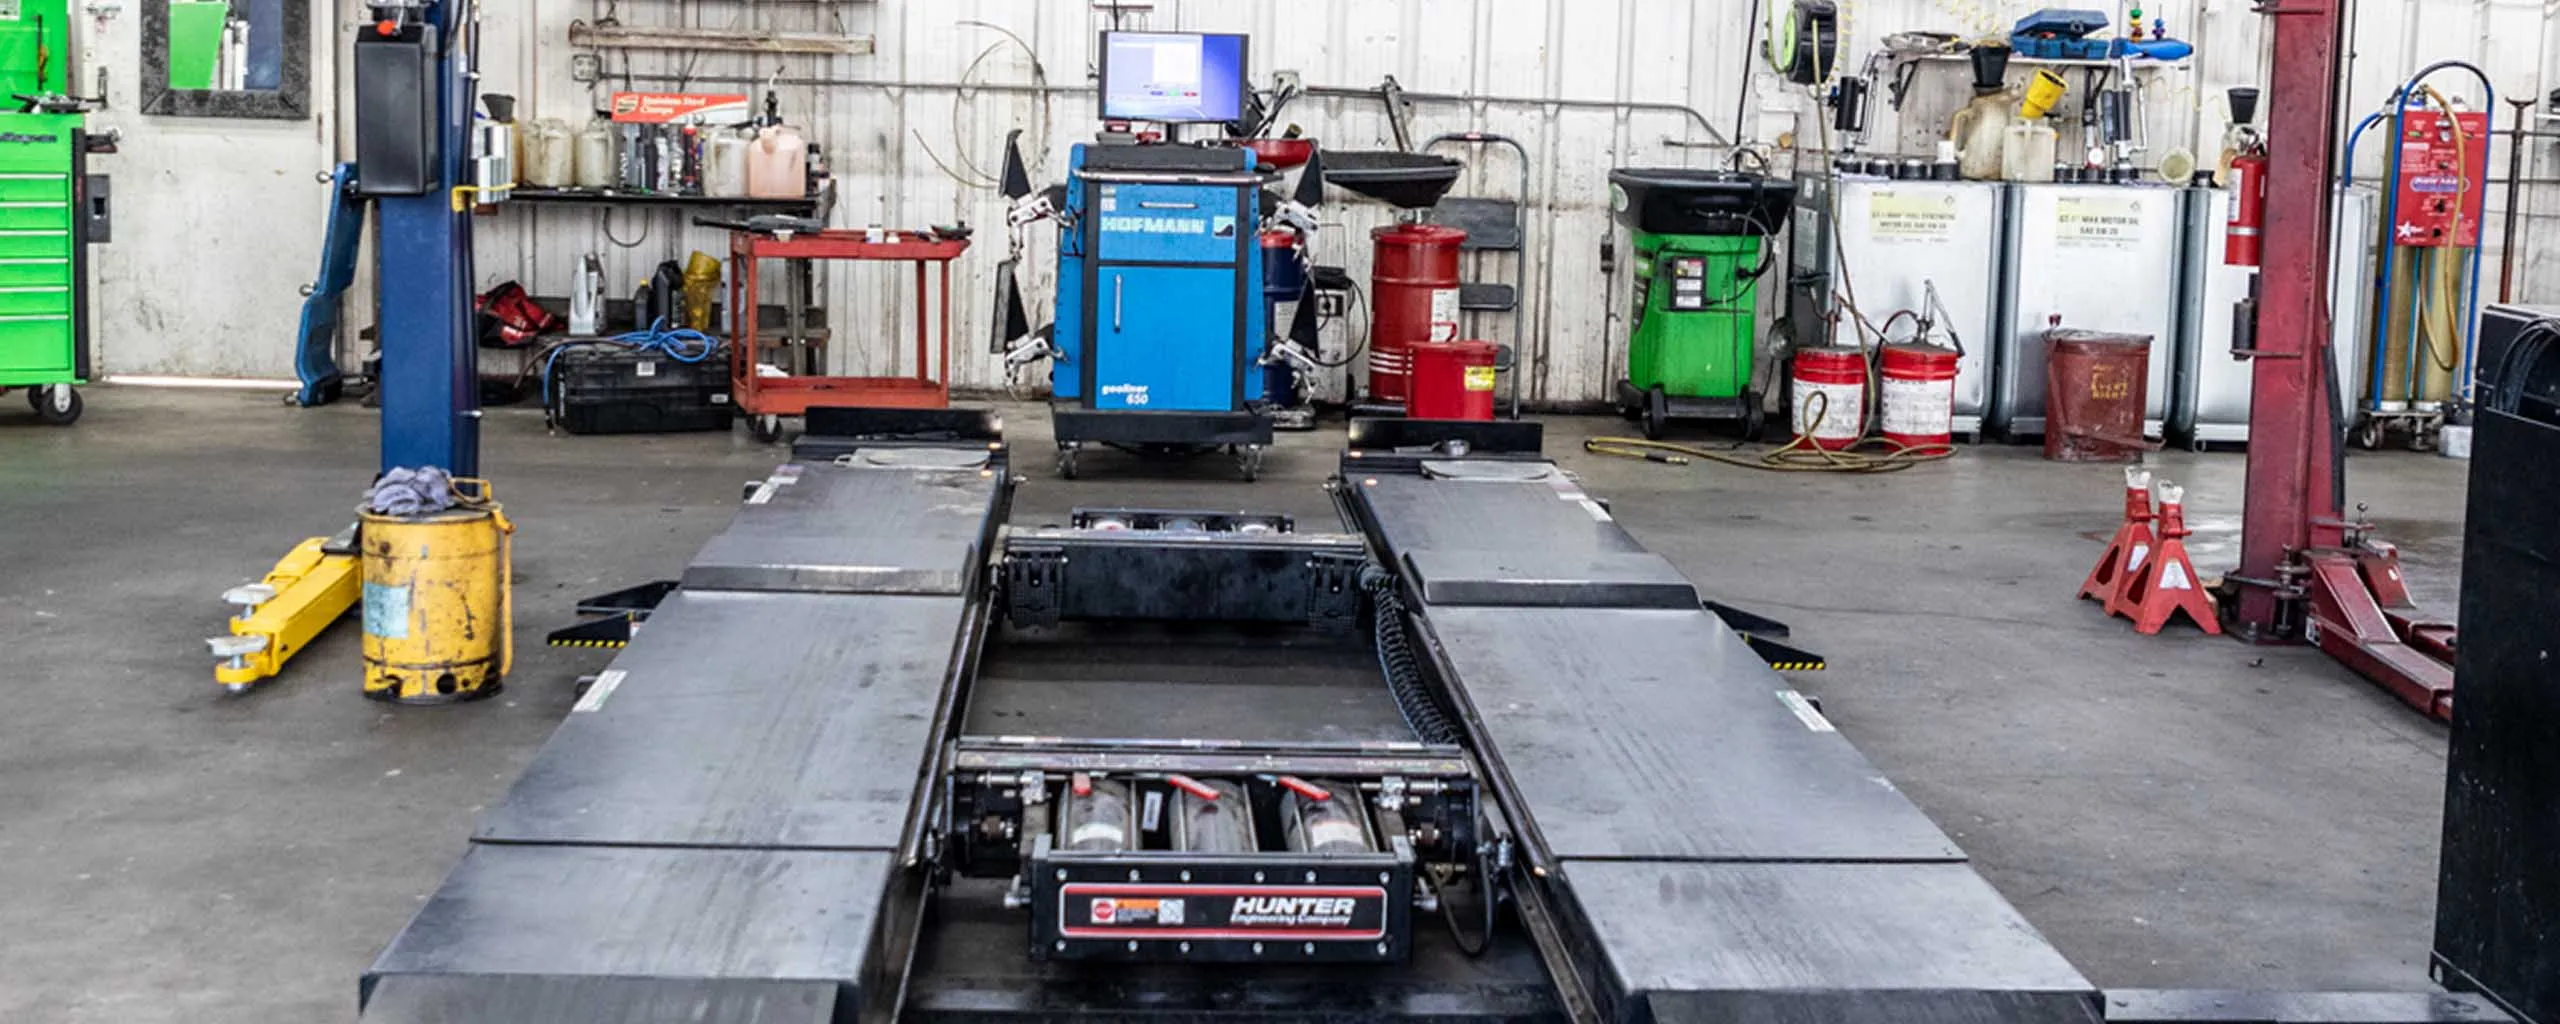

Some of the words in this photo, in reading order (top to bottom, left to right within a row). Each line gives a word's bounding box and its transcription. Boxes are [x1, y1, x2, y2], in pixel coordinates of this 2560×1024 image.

[1101, 216, 1204, 234] HOFMANN
[1232, 897, 1356, 914] HUNTER
[1230, 914, 1296, 926] Engineering
[1298, 914, 1351, 926] Company
